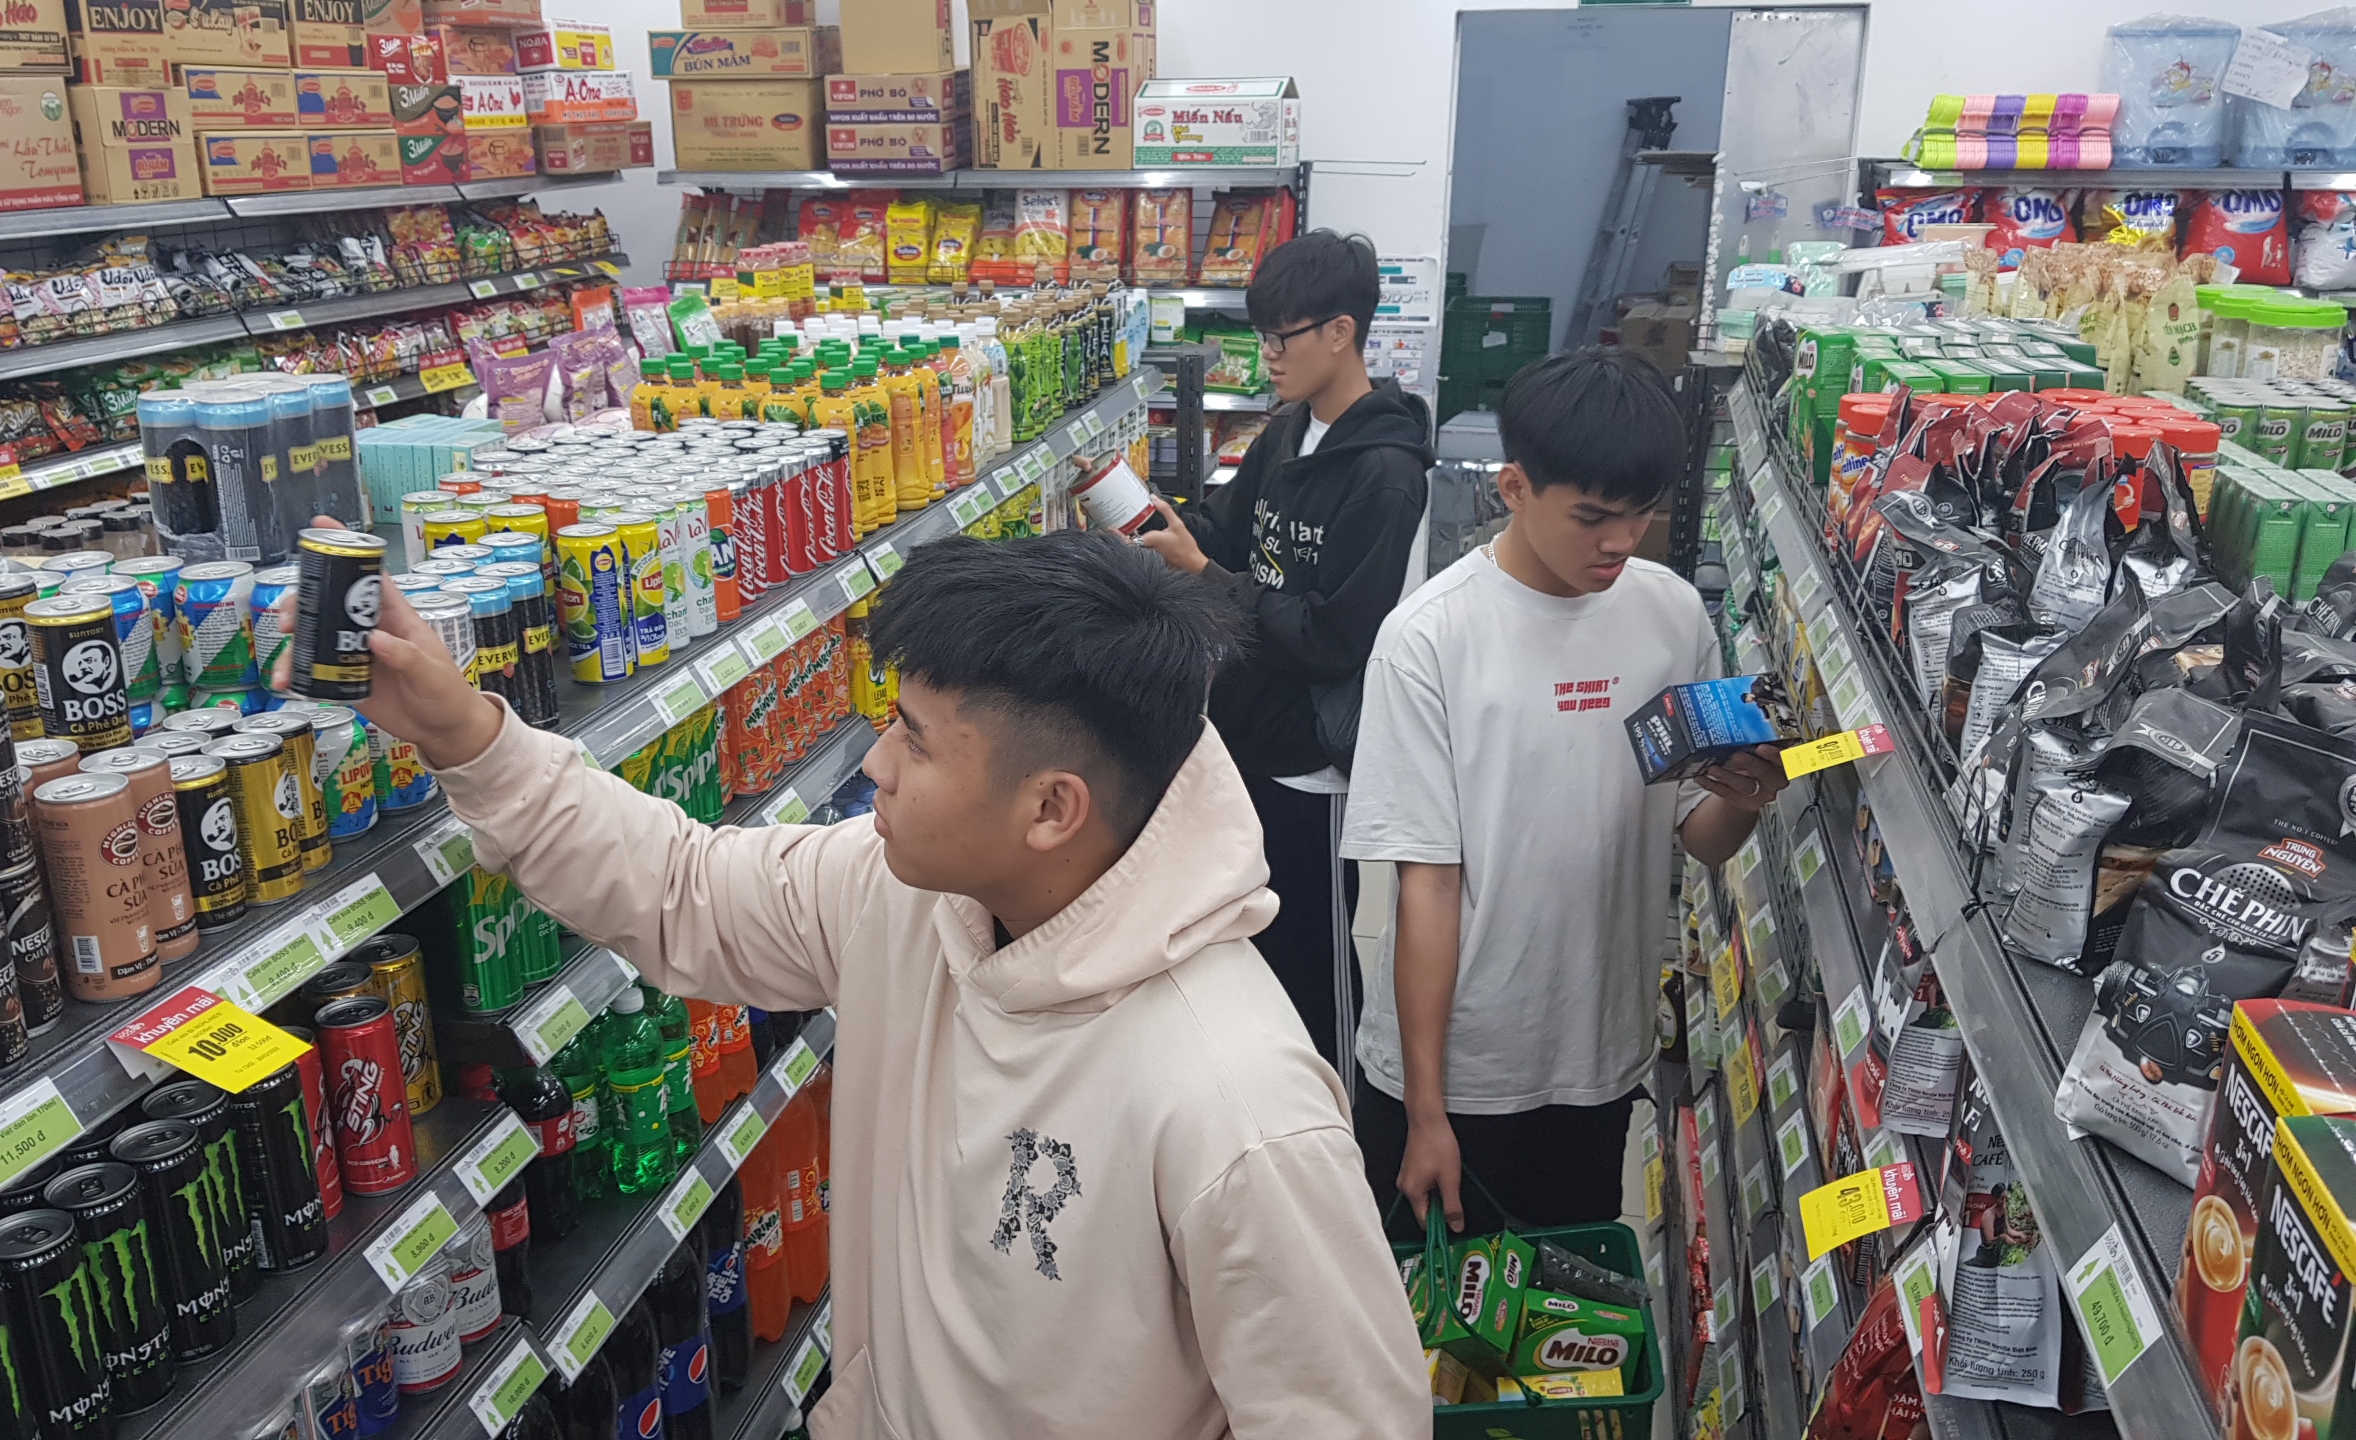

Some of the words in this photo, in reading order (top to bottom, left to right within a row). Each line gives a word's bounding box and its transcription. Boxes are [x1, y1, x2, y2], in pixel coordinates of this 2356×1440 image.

[90, 3, 159, 30] ENJOY
[304, 0, 362, 22] ENJOY
[684, 57, 713, 72] BÚN
[832, 93, 855, 102] VIFON
[860, 87, 884, 99] PHỞ
[889, 86, 906, 98] BÒ
[1091, 41, 1110, 155] MODERN
[112, 120, 181, 137] MODERN
[1172, 109, 1209, 124] Miến
[1212, 107, 1243, 123] Nấu
[832, 141, 855, 150] VIFON
[860, 136, 883, 147] PHỞ
[889, 135, 906, 147] BÒ
[1022, 195, 1059, 208] Select
[2012, 197, 2063, 224] OMO
[2124, 189, 2179, 216] OMO
[2221, 189, 2283, 215] OMO
[1797, 356, 1815, 371] MILO
[2308, 426, 2342, 439] MILO
[816, 465, 837, 557] Coca-Cola
[69, 628, 104, 640] SUNTORY
[529, 631, 550, 646] EVER
[478, 650, 518, 667] EVERVE
[1576, 679, 1609, 695] SHIRT
[63, 689, 127, 722] BOSS
[70, 722, 84, 733] Cà
[87, 717, 110, 732] Phê
[138, 792, 175, 819] HIGHLAN
[102, 820, 137, 849] HIGHLAN
[2274, 819, 2288, 829] THE
[142, 847, 165, 867] CÀ
[168, 843, 182, 859] PH
[2265, 848, 2321, 873] NGUYÊN
[2285, 841, 2317, 858] TRUNG
[201, 849, 243, 882] BOS
[106, 879, 130, 898] CÀ
[133, 872, 145, 891] PH
[209, 881, 222, 892] Cà
[328, 913, 341, 925] Cafe
[350, 898, 365, 912] BOSS
[2239, 899, 2310, 947] PHIN
[11, 922, 50, 956] NESCA
[2227, 917, 2240, 926] CHO
[2259, 929, 2267, 937] CÀ
[247, 965, 260, 979] Cafe
[271, 949, 288, 965] BOSS
[2205, 949, 2220, 963] 5
[186, 995, 215, 1016] mãi
[188, 1022, 244, 1062] 10.000
[400, 1000, 424, 1068] STING
[2232, 1016, 2246, 1048] THƠM
[2246, 1042, 2265, 1074] NGON
[2263, 1063, 2280, 1095] HƠN
[347, 1060, 379, 1132] STING
[26, 1112, 36, 1125] lon
[37, 1099, 57, 1117] 170ml
[2224, 1062, 2275, 1158] NESCAF
[0, 1136, 37, 1166] 11,500
[37, 1129, 46, 1143] đ
[2236, 1137, 2252, 1173] 3in1
[2274, 1133, 2292, 1168] THƠM
[2293, 1163, 2315, 1202] NGON
[2312, 1195, 2331, 1230] HƠN
[989, 1127, 1082, 1281] R
[1837, 1186, 1867, 1225] 43.000
[429, 1233, 436, 1242] đ
[744, 1208, 780, 1249] MIRINDA
[1507, 1254, 1518, 1283] MILO
[177, 1276, 231, 1317] MONS
[719, 1284, 734, 1304] OF
[1461, 1260, 1482, 1319] MILO
[2284, 1271, 2303, 1313] 3in1
[1548, 1300, 1575, 1310] MILO
[2091, 1301, 2112, 1336] 49,700
[1547, 1340, 1619, 1365] MILO
[360, 1357, 394, 1387] Tig
[1948, 1355, 1967, 1368] Khối
[1970, 1359, 1995, 1375] lượng
[2021, 1369, 2038, 1379] 250
[2040, 1370, 2045, 1380] g
[49, 1380, 110, 1425] MONS
[326, 1405, 357, 1434] Tig
